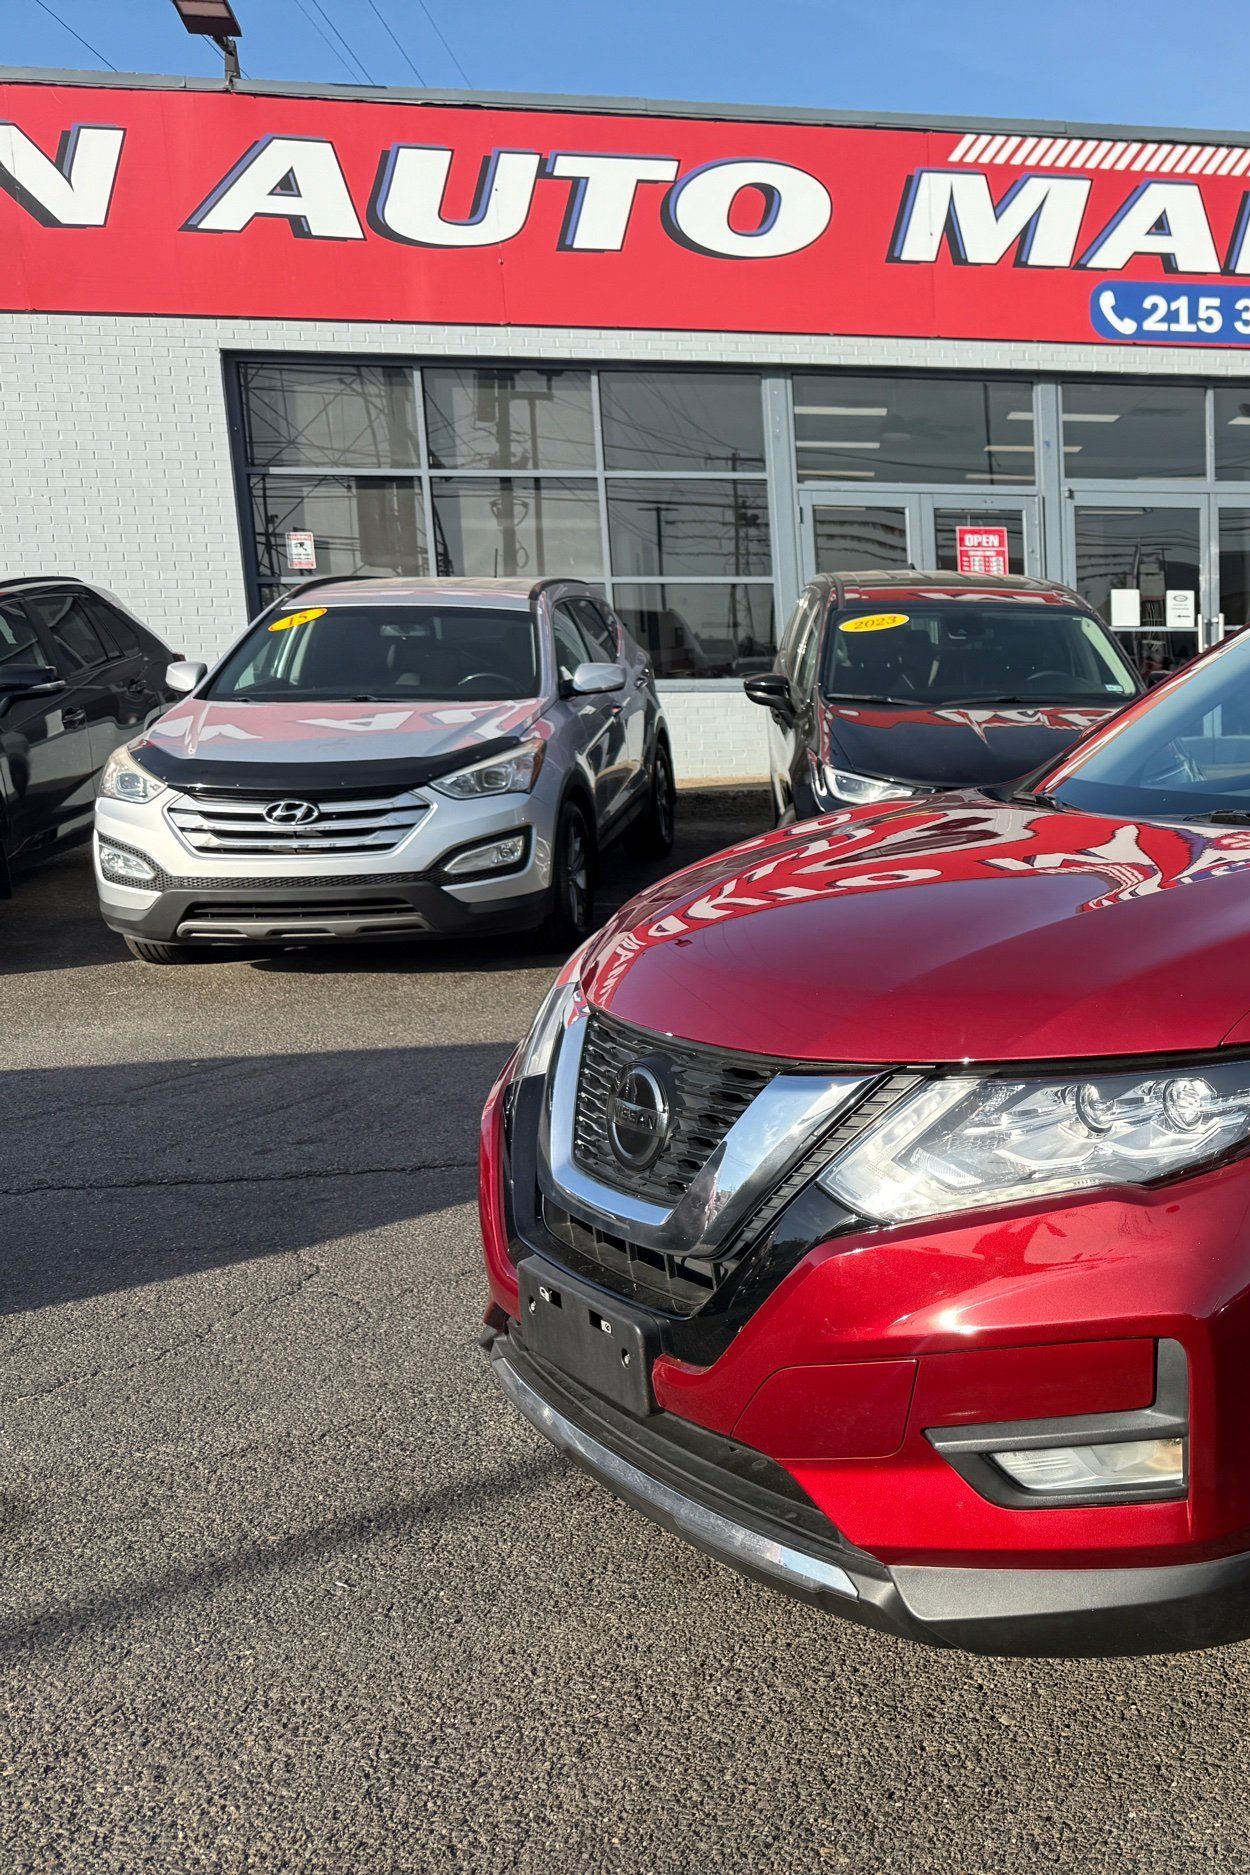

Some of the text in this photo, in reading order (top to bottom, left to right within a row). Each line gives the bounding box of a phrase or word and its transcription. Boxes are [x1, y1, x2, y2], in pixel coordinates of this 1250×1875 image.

[178, 133, 833, 260] AUTO
[1142, 295, 1223, 334] 215
[964, 534, 1000, 547] OPEN
[854, 616, 897, 630] 2023
